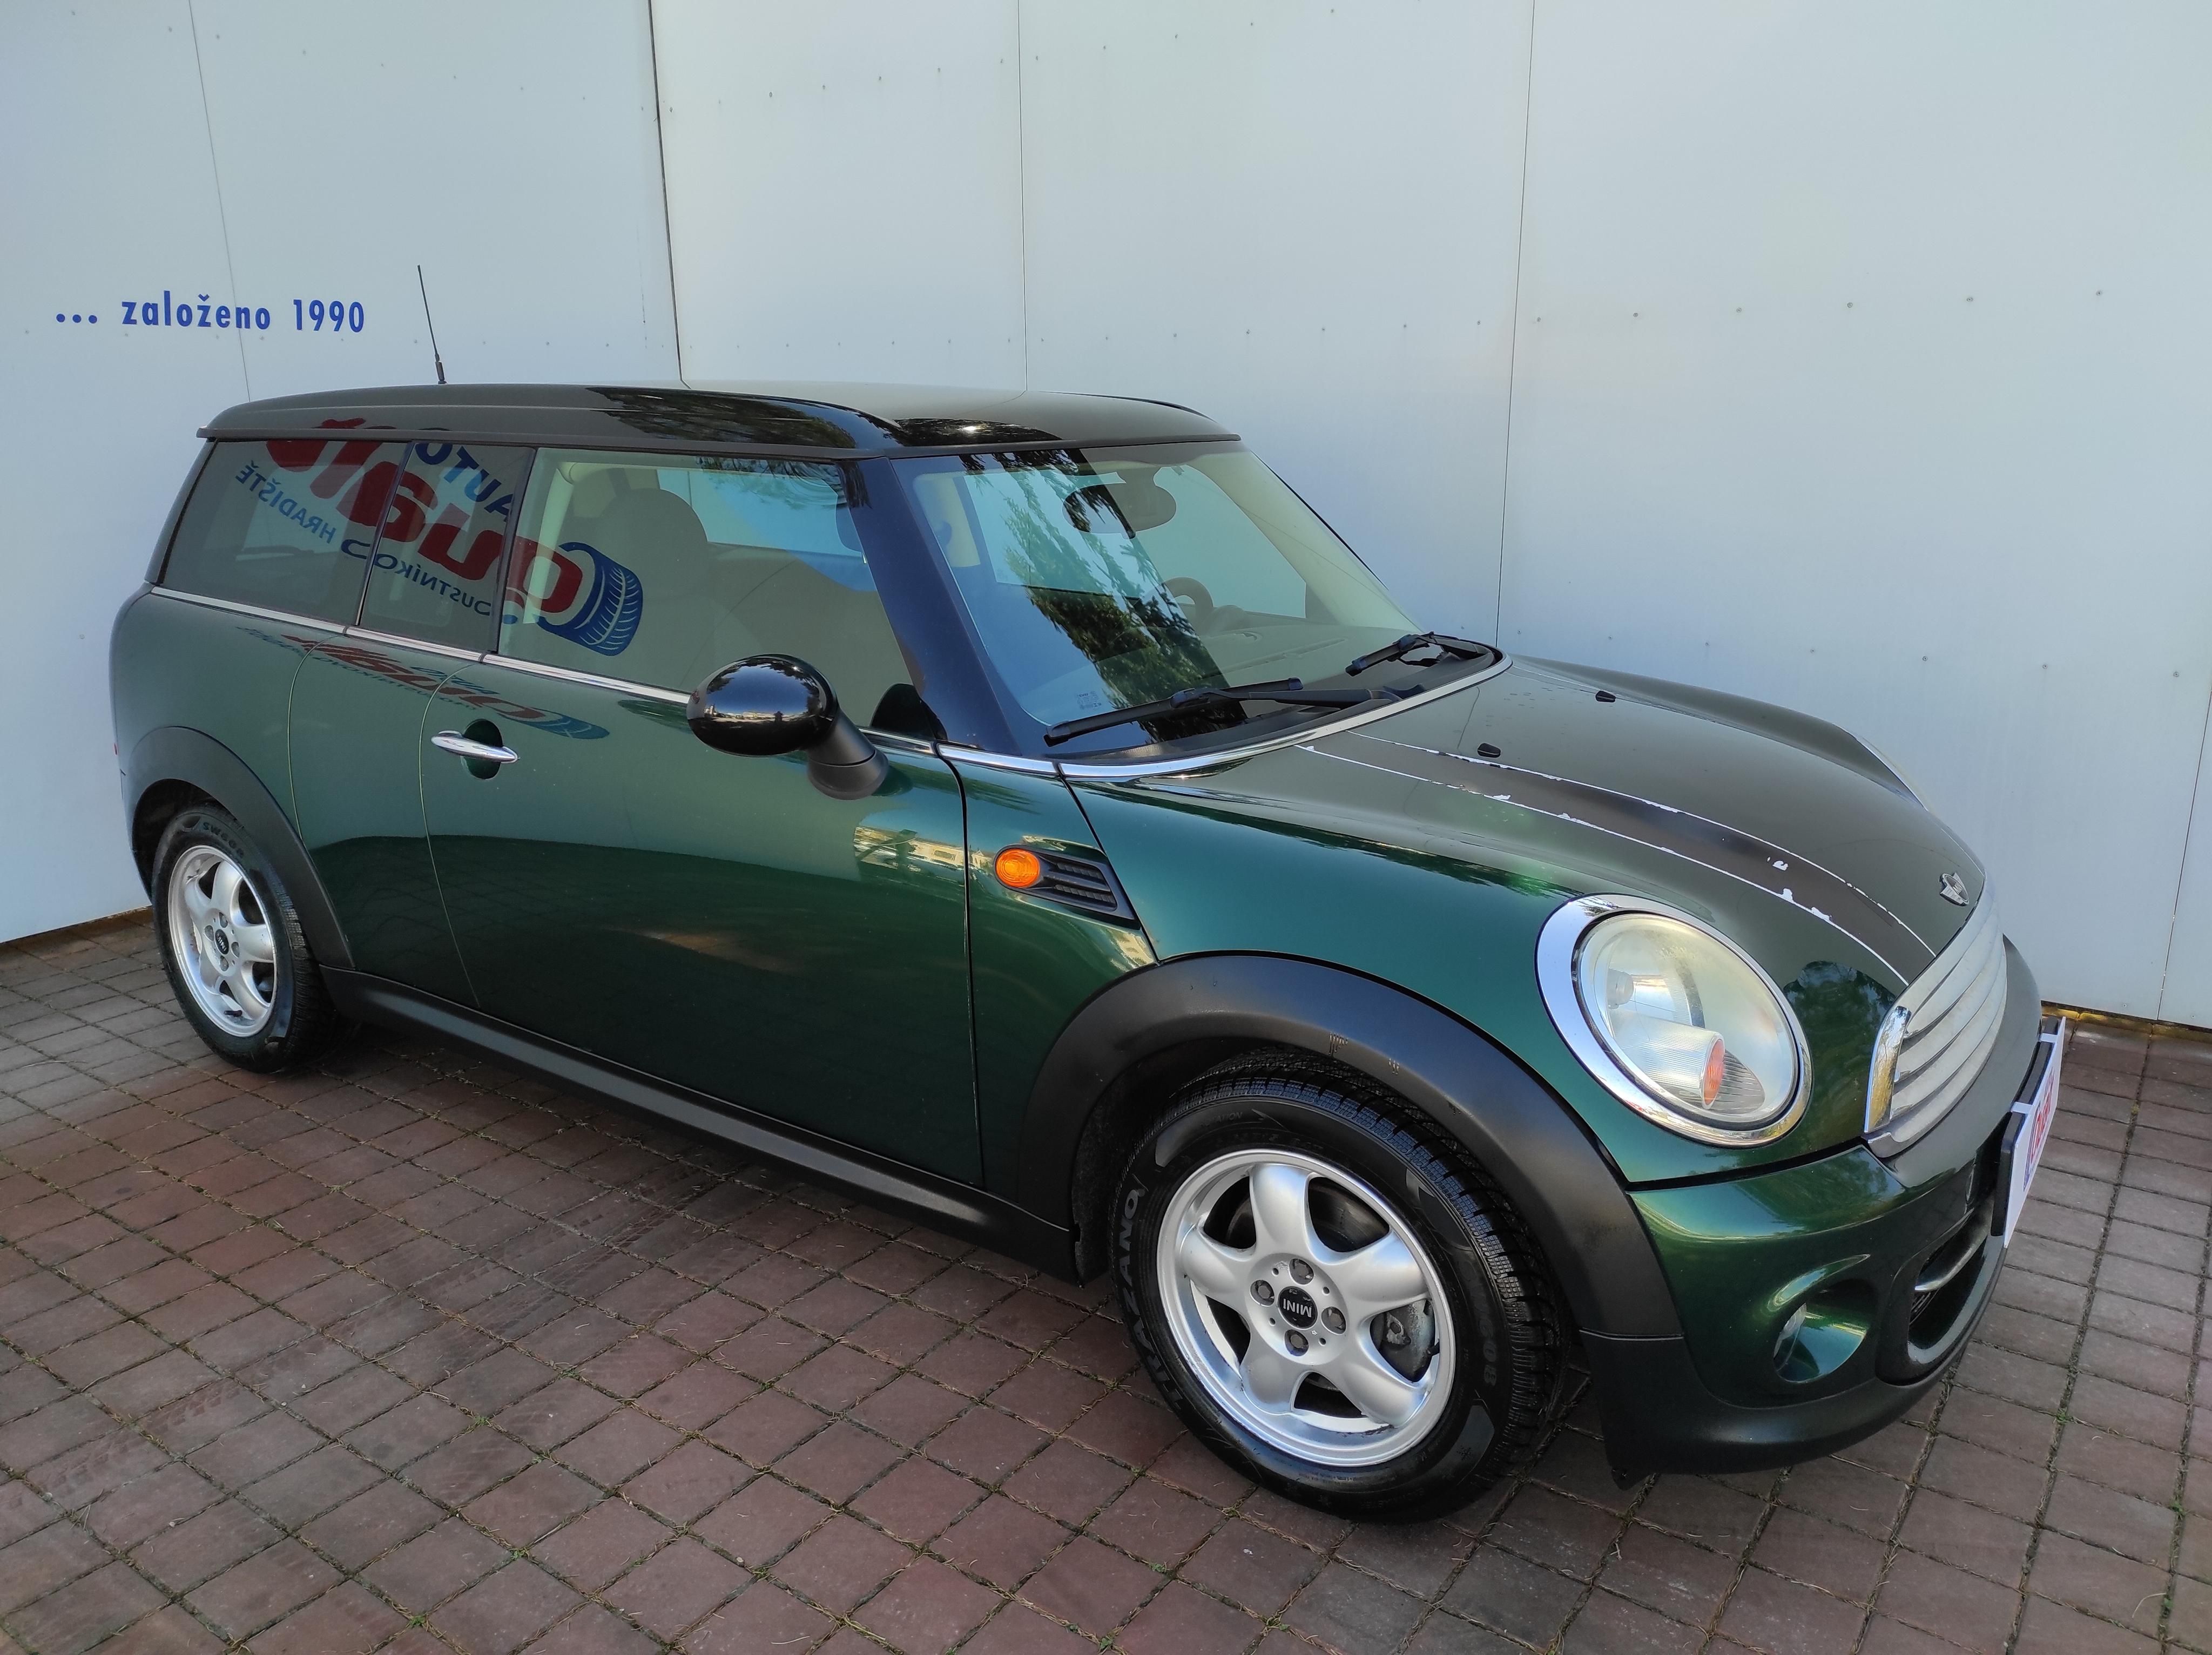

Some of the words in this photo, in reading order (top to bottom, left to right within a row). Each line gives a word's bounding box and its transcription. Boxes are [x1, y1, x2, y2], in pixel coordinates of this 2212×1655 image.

[122, 290, 270, 330] založeno
[293, 299, 365, 333] 1990
[1119, 1188, 1183, 1409] TRAZANO
[1283, 1298, 1312, 1318] MINI
